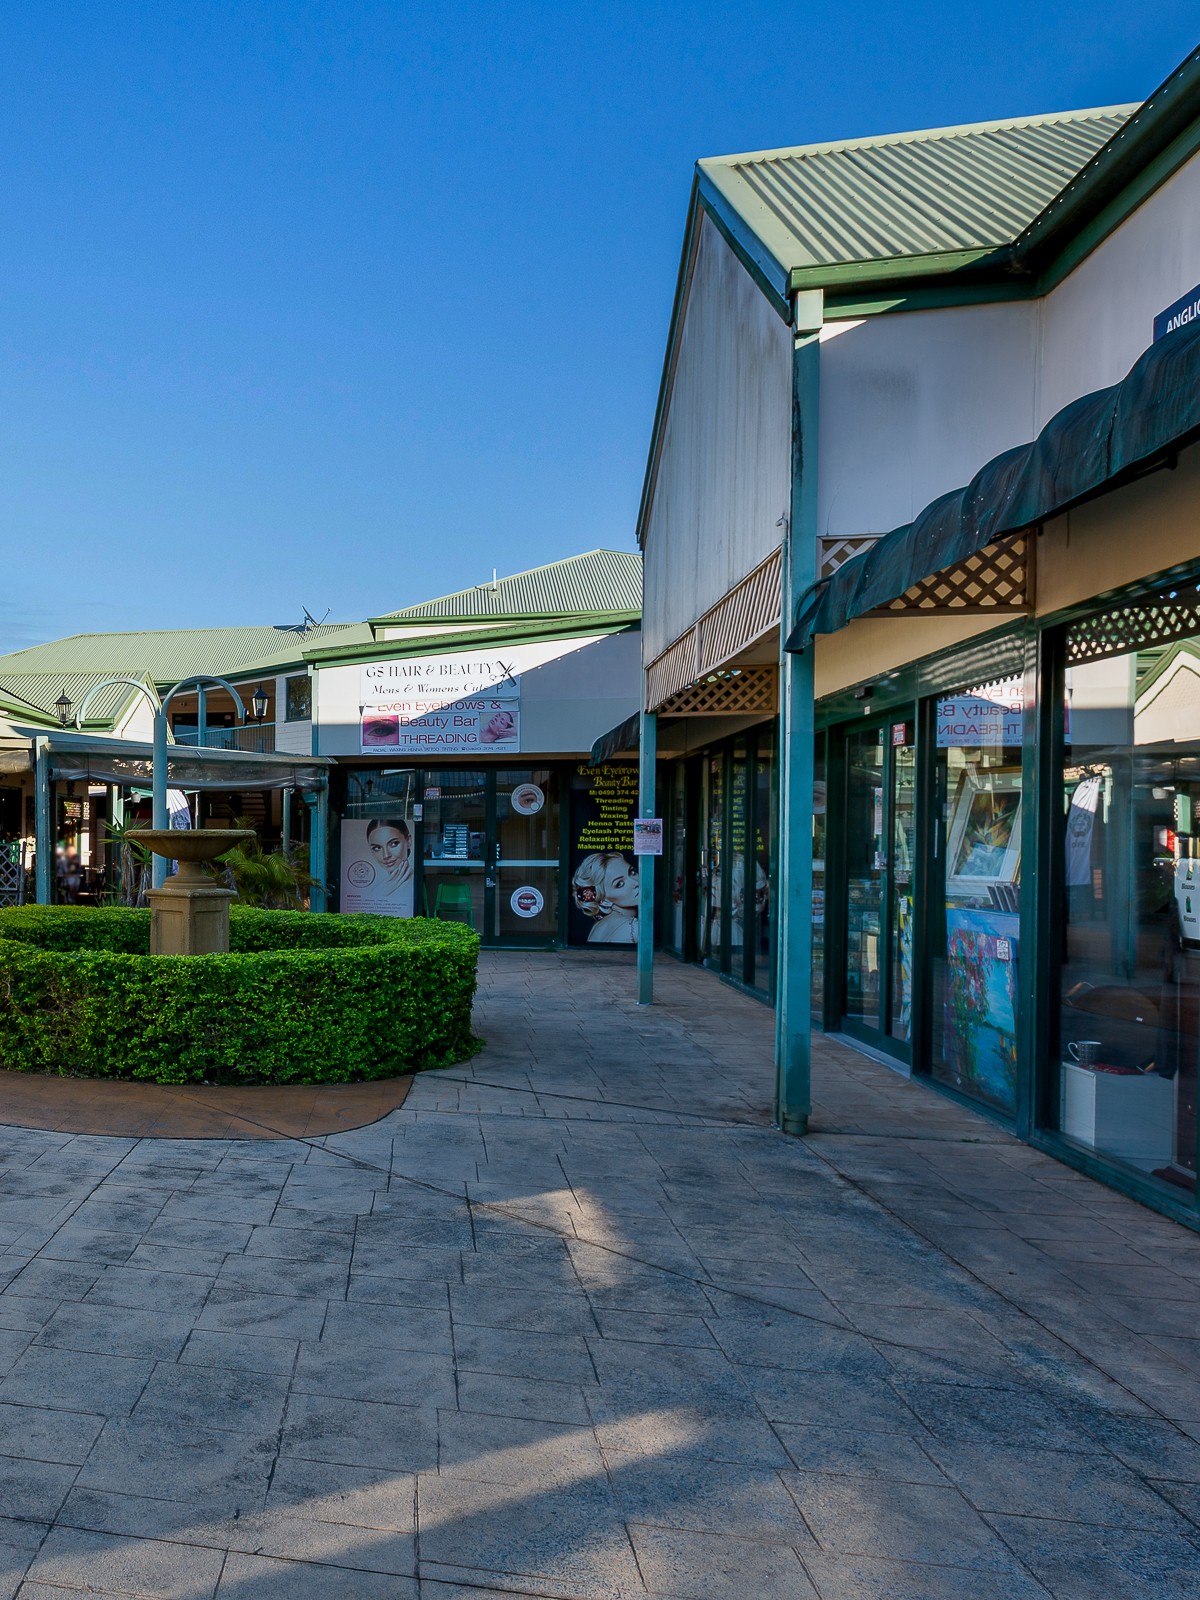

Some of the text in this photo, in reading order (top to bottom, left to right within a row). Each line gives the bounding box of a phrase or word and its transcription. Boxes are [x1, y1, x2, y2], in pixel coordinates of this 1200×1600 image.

[366, 663, 494, 678] GS HAIR & BEAUTY
[372, 682, 488, 695] Mens & Womens Cuts
[377, 700, 502, 713] Even Eyebrows &
[400, 715, 478, 729] Beauty Bar
[401, 733, 477, 745] THREADING
[577, 764, 639, 778] Even Eyebrow
[593, 775, 638, 789] Beauty Bar
[595, 797, 634, 805] Threading
[577, 843, 606, 851] Makeup
